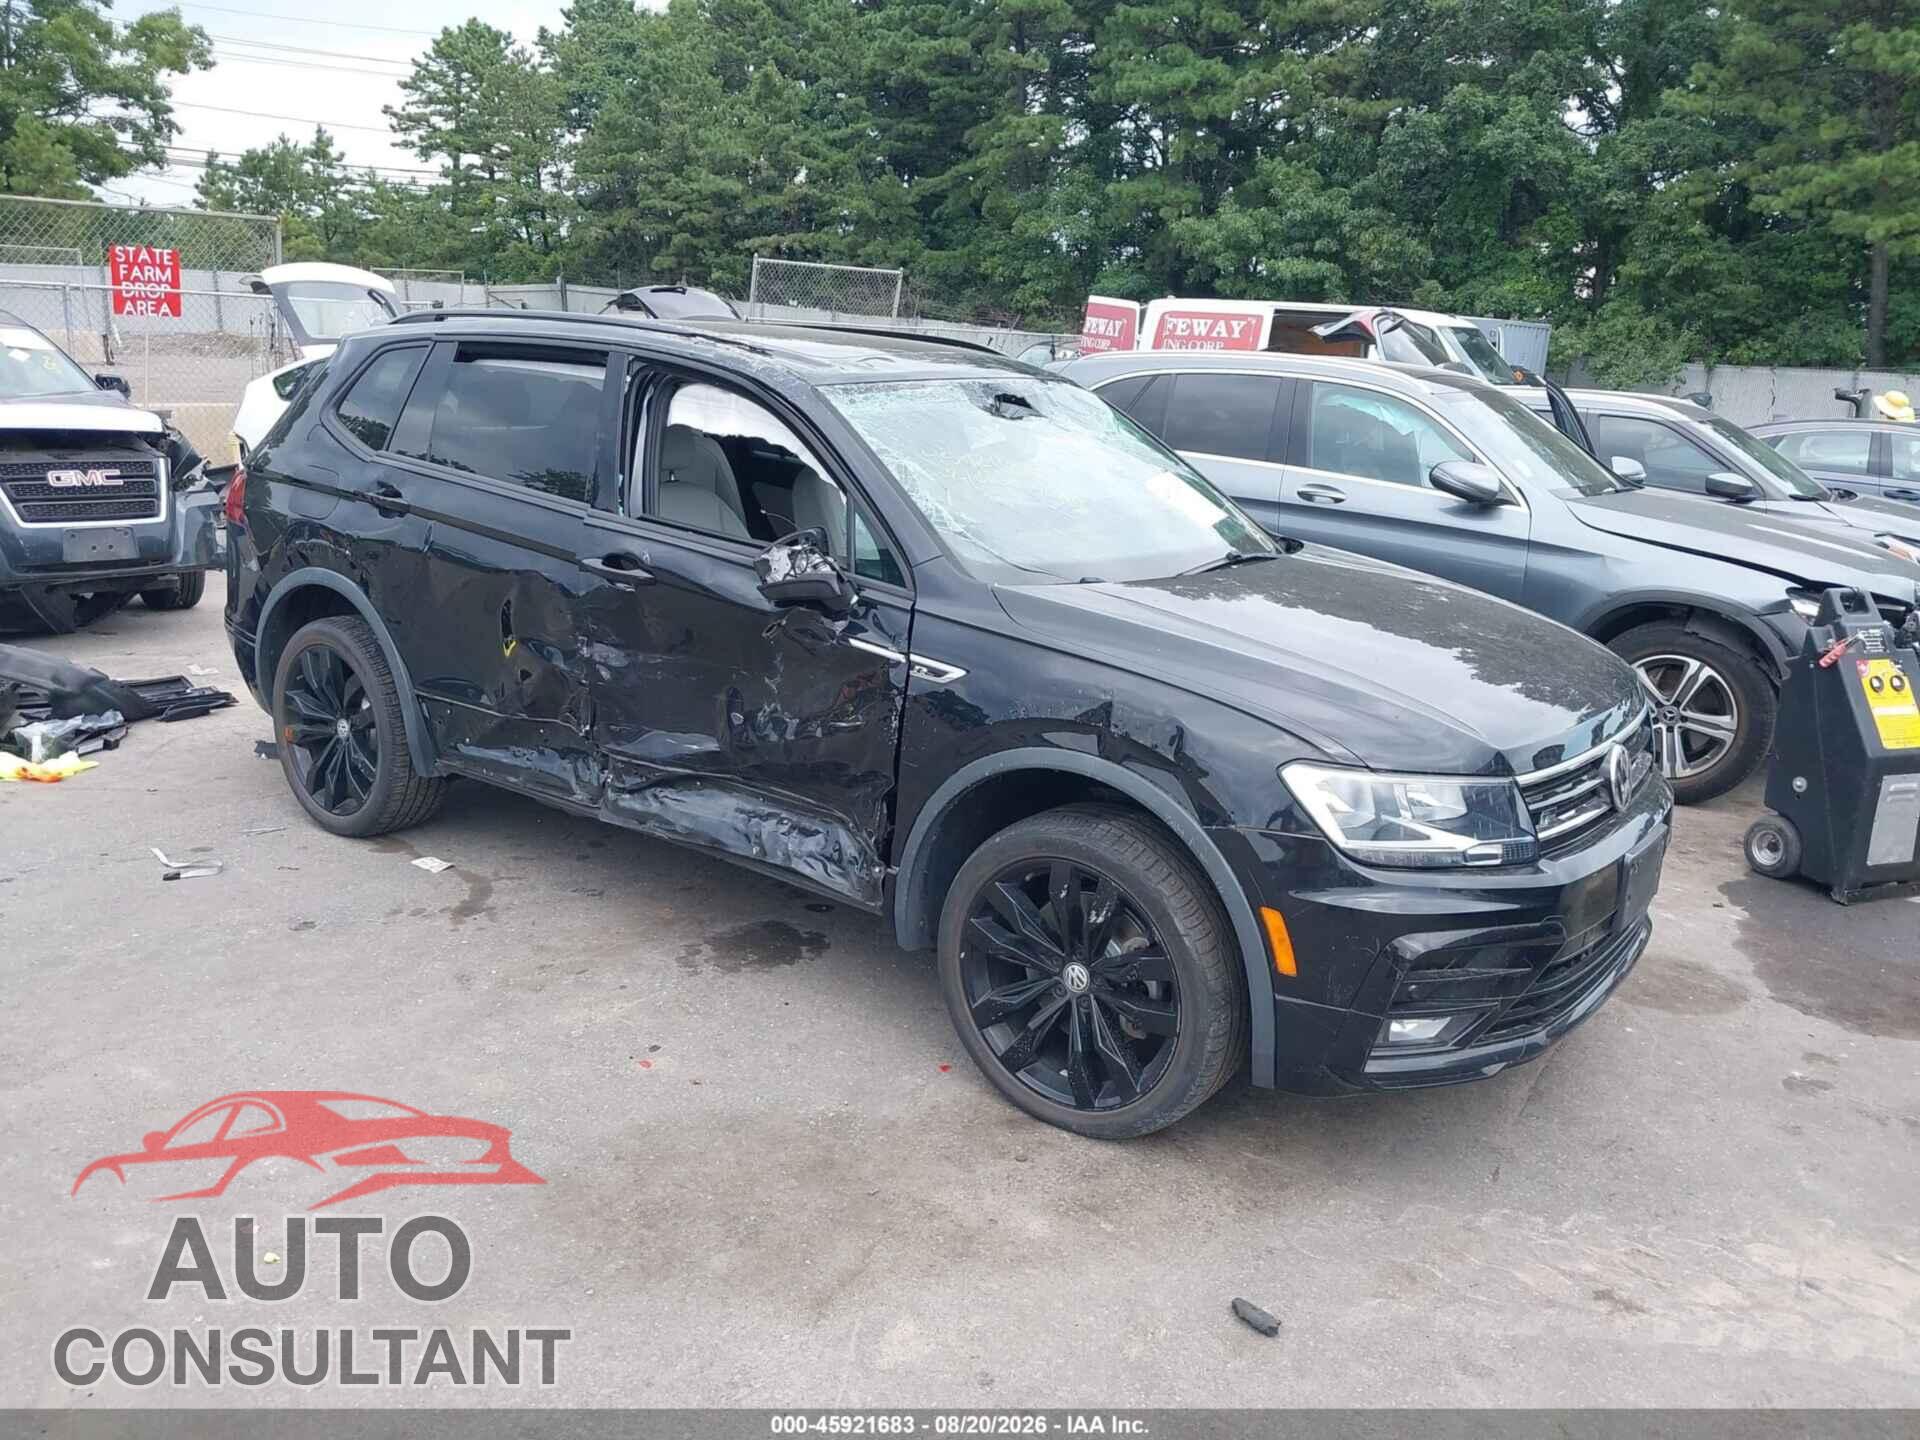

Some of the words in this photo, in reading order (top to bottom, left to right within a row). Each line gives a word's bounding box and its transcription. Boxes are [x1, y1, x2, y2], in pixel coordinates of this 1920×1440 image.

[114, 246, 173, 265] STATE
[119, 264, 172, 282] FARM
[121, 281, 171, 299] DROP
[122, 300, 175, 318] AREA
[1162, 317, 1247, 338] FEWAY
[47, 469, 124, 487] GMC
